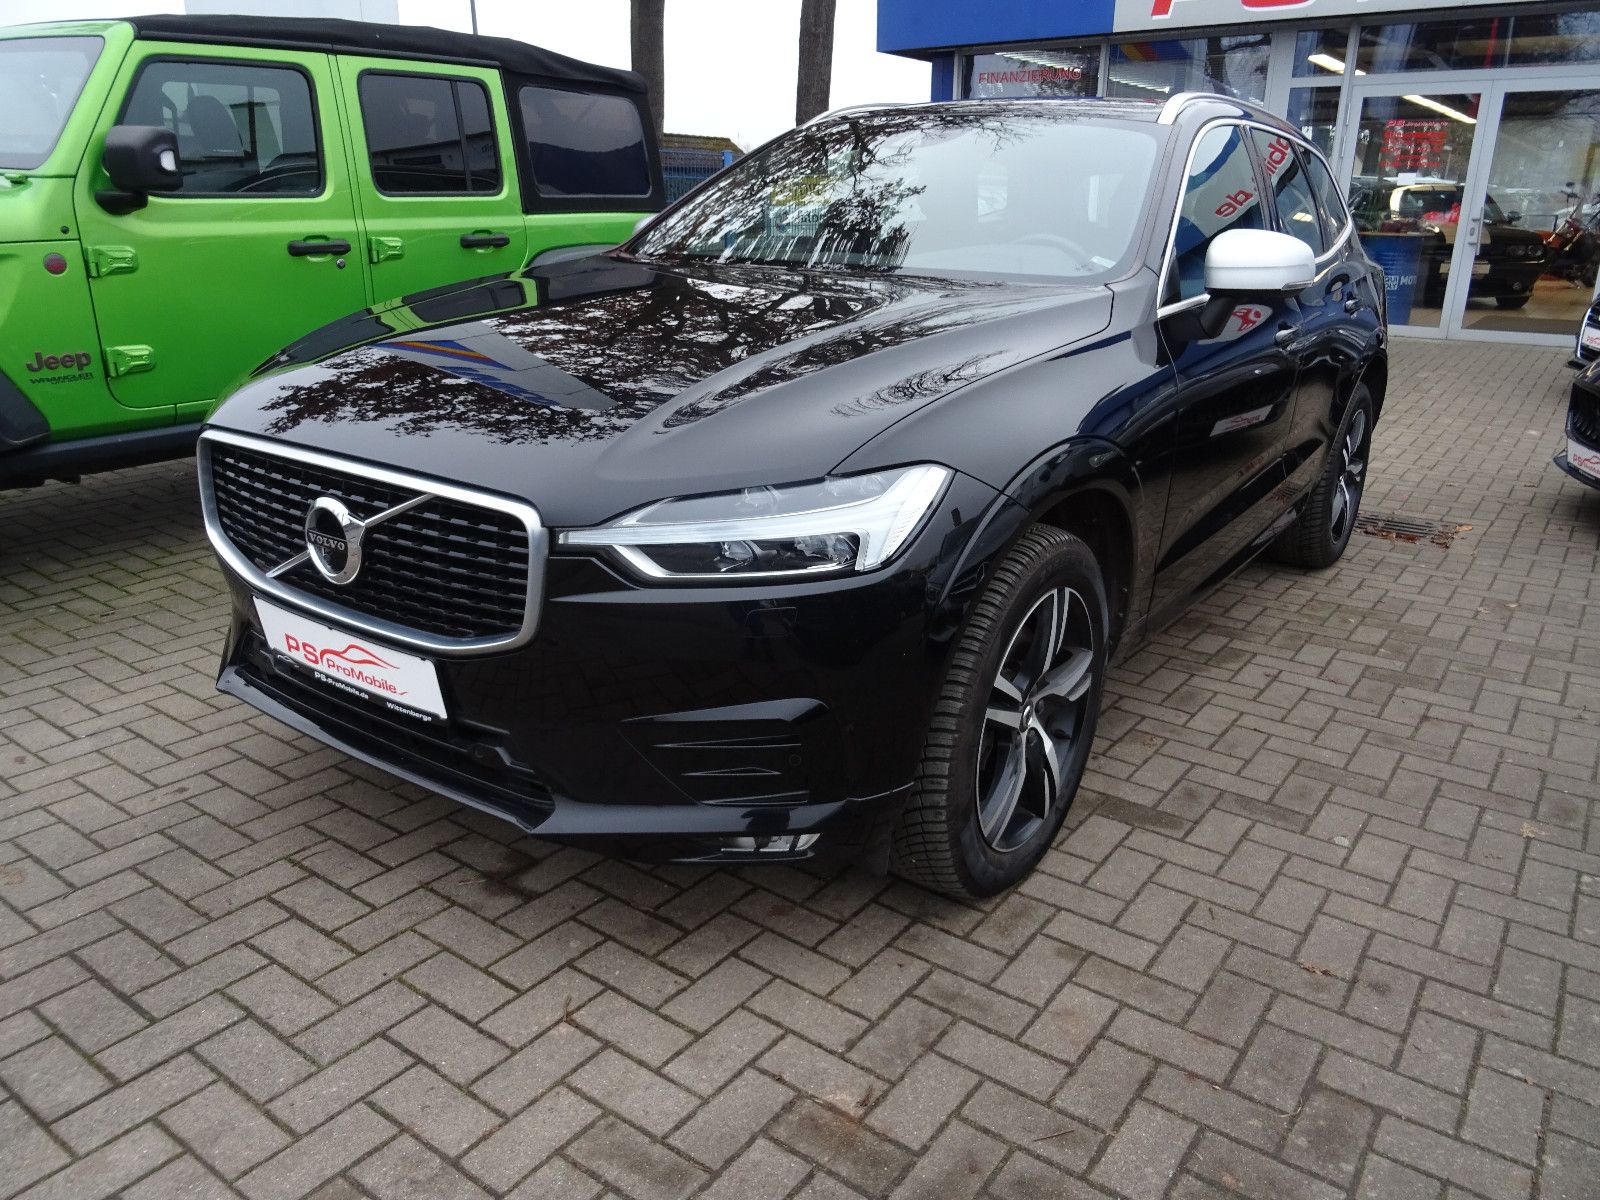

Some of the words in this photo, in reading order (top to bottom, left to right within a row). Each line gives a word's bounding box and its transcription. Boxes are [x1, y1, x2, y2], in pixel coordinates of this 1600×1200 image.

[978, 67, 1081, 84] FINANZIERUNG
[26, 351, 91, 372] Jeep
[308, 532, 345, 551] VOLVO
[284, 632, 319, 665] PS
[326, 657, 397, 695] ProMobile
[314, 671, 369, 700] PS-ProMobile.de
[386, 701, 432, 722] Wittenberge
